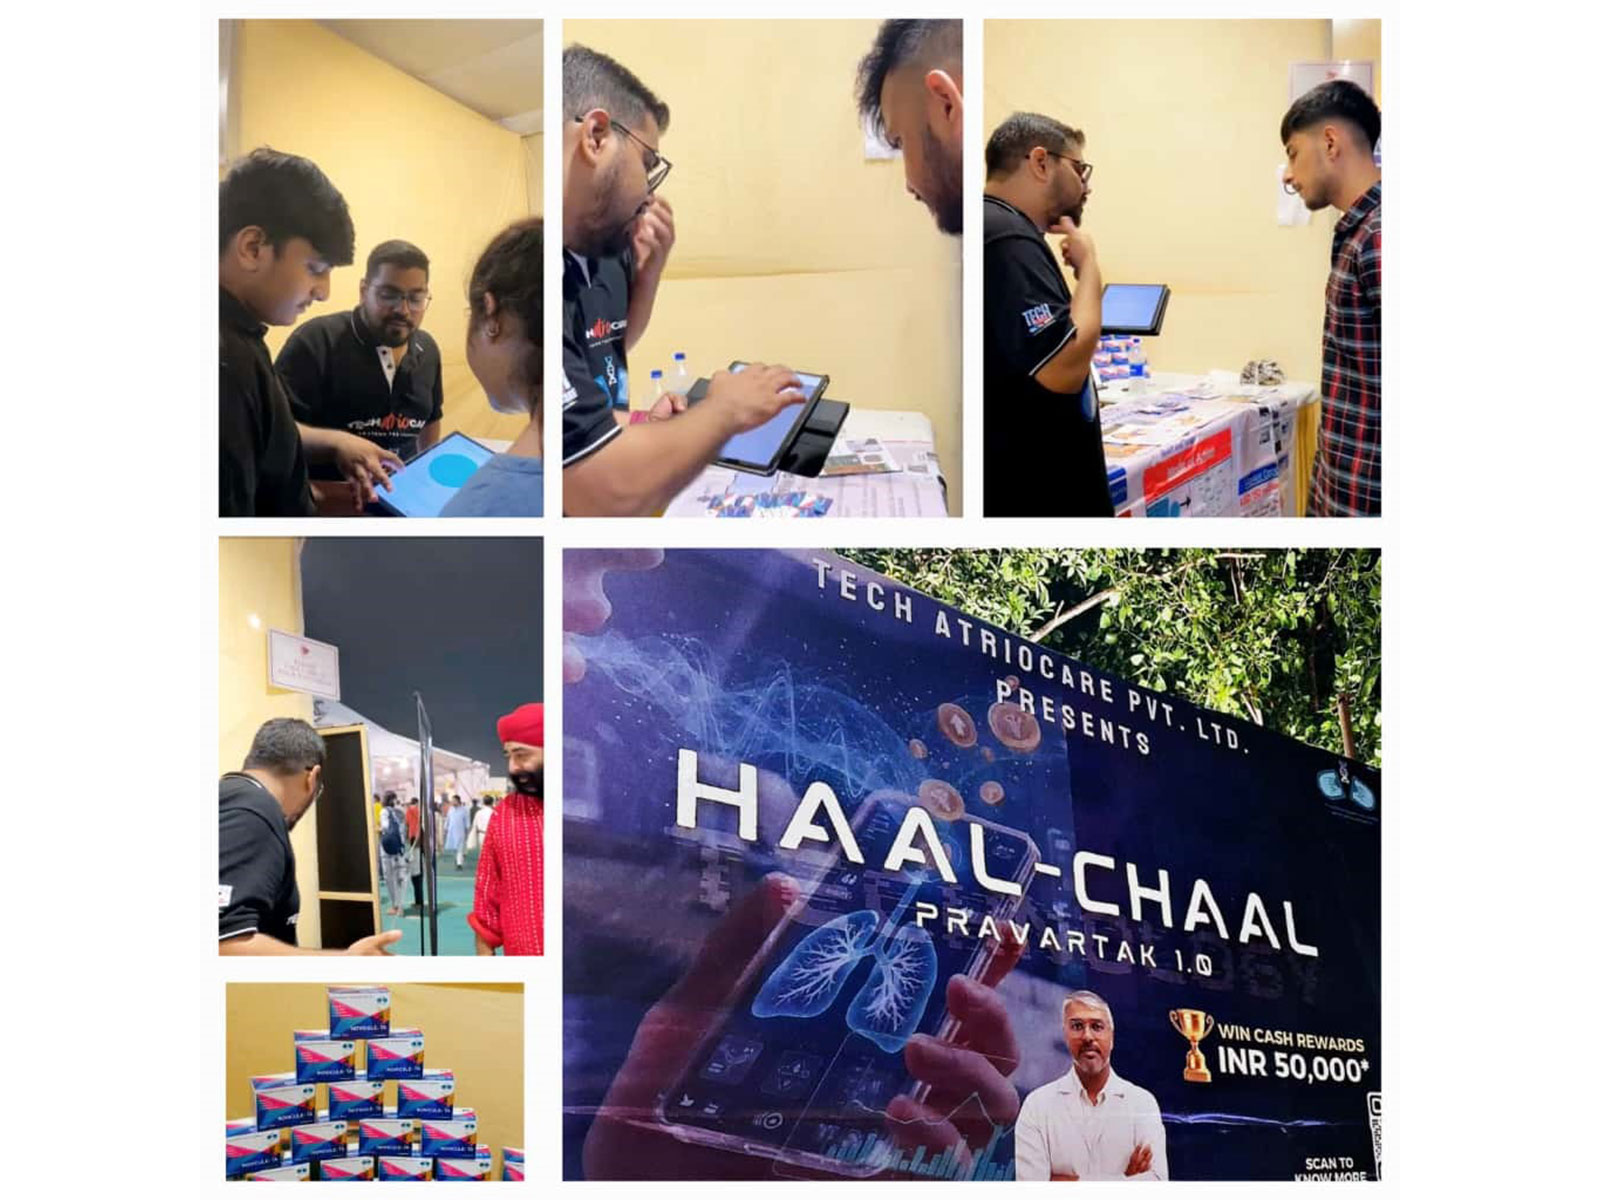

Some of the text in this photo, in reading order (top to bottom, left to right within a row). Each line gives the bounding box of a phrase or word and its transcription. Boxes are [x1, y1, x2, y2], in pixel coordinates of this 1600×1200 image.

[812, 558, 1250, 755] TECH ATRIOCARE PVT. LTD.
[996, 679, 1151, 756] PRESENTS
[676, 748, 1319, 957] HAAL-CHAAL
[915, 902, 1213, 977] PRAVARTAK 1.0
[1218, 1023, 1365, 1053] WIN CASH REWARDS
[1218, 1046, 1267, 1077] INR
[1305, 1157, 1354, 1170] SCAN TO
[1334, 1171, 1367, 1181] MORE
